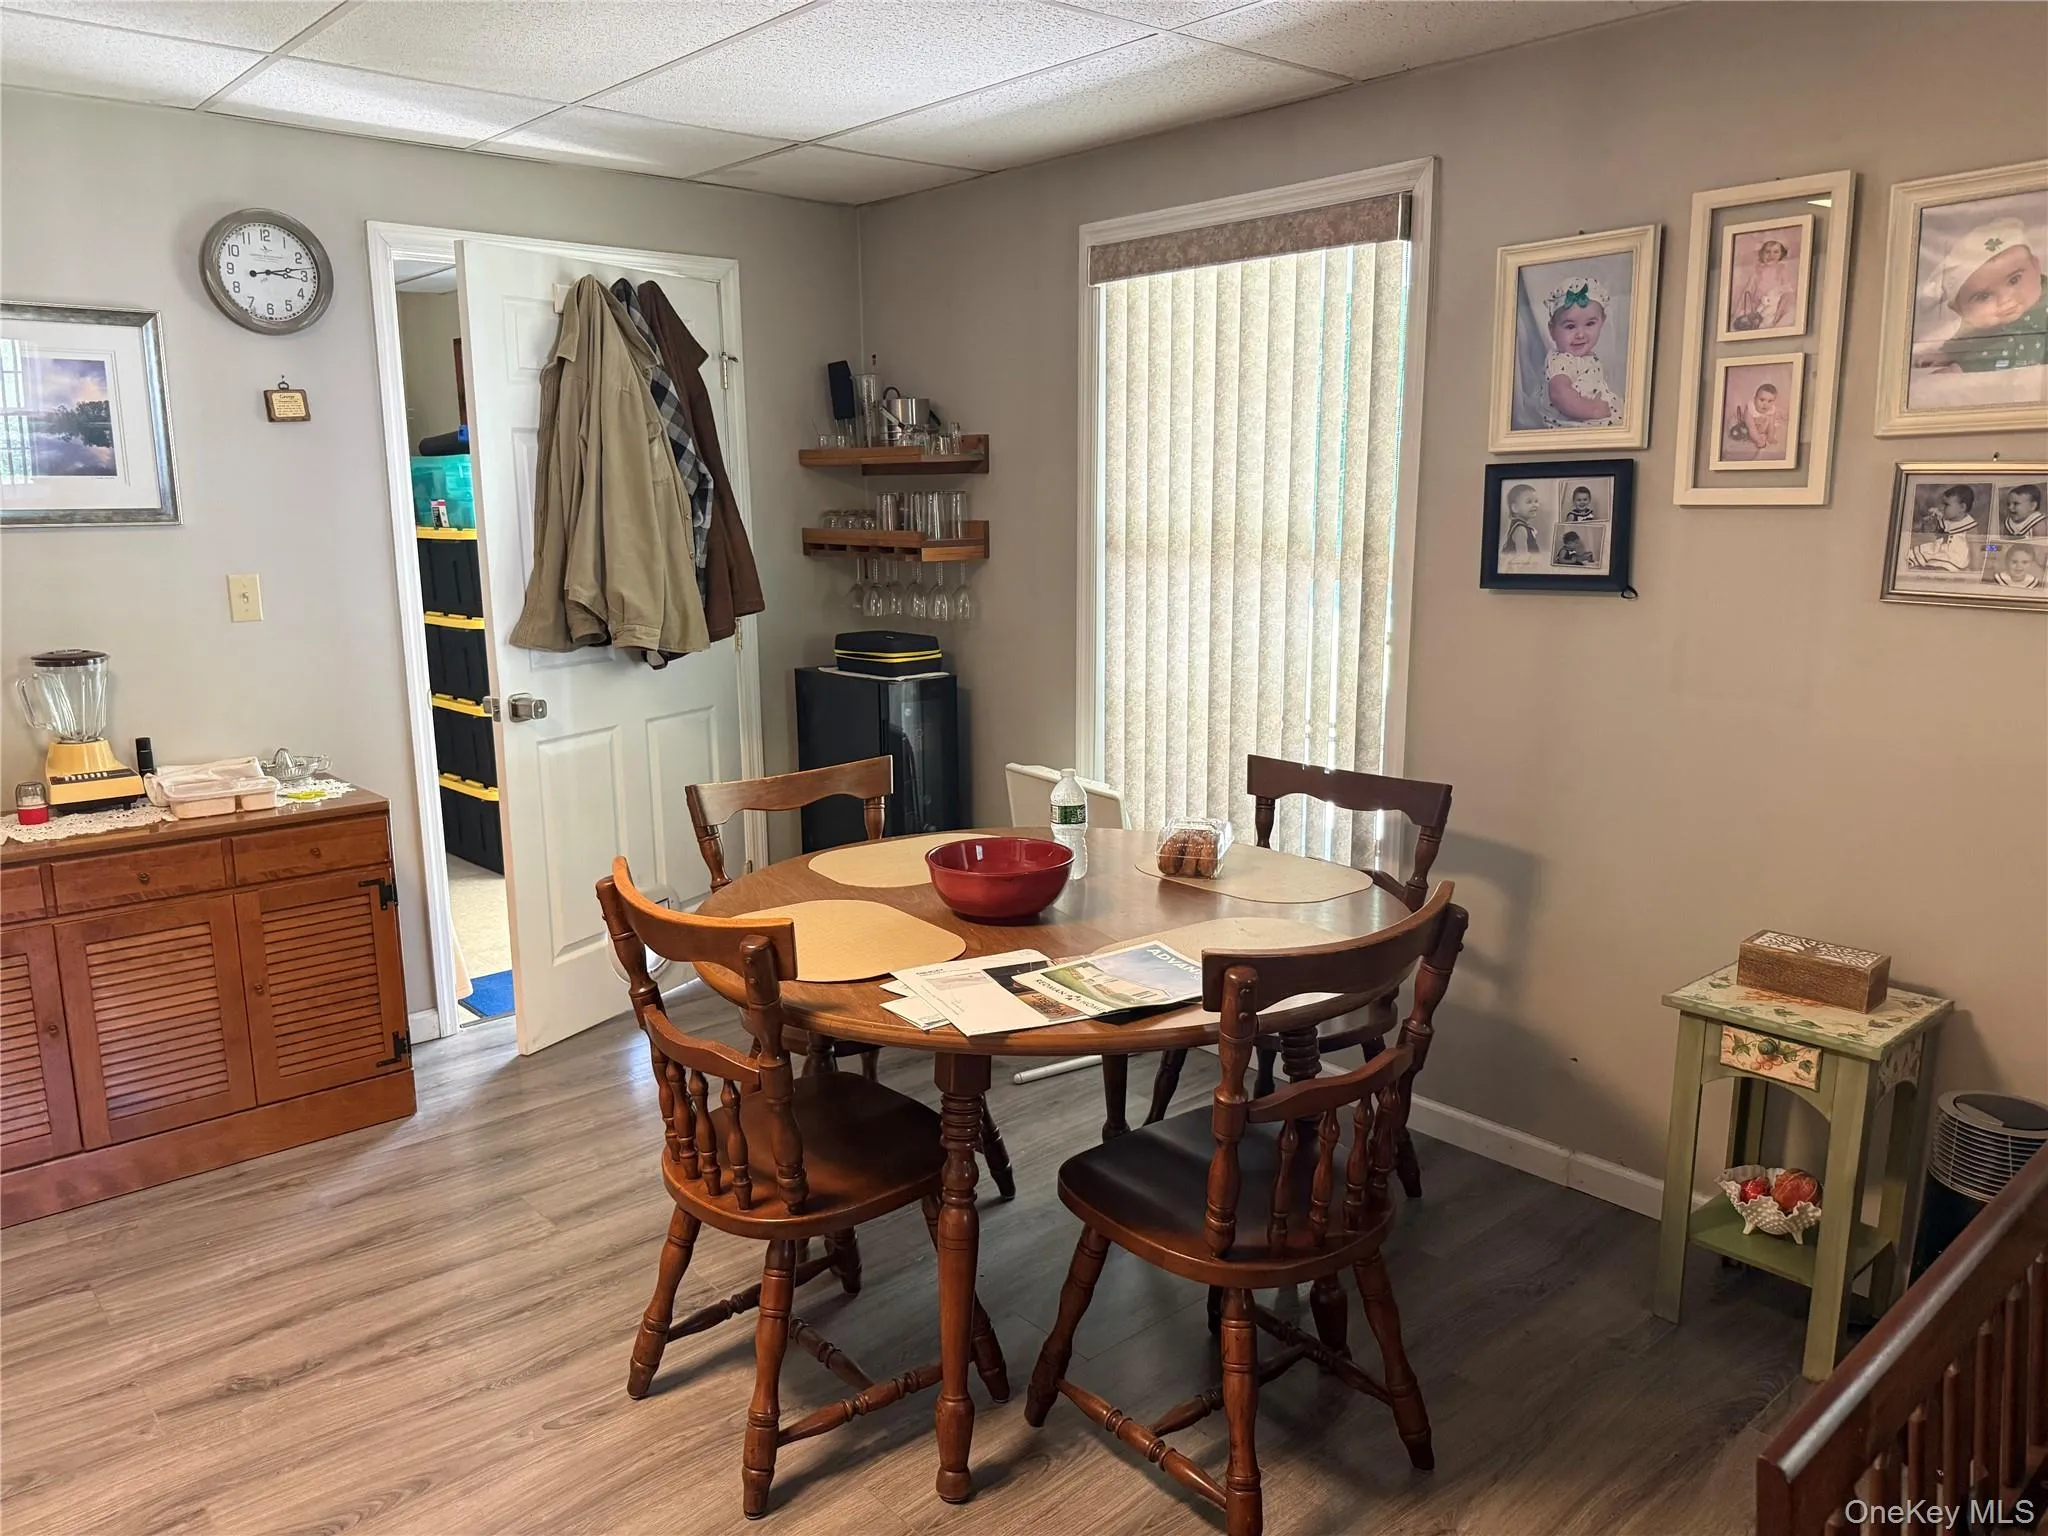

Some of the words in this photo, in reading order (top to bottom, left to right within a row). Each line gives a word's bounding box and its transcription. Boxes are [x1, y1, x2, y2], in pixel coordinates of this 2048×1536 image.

[241, 231, 251, 245] 11
[259, 228, 271, 242] 12
[227, 243, 240, 257] 10
[294, 251, 303, 265] 2
[226, 262, 235, 275] 9
[300, 270, 309, 283] 3
[232, 280, 241, 294] 8
[296, 287, 305, 300] 4
[247, 295, 255, 309] 7
[266, 302, 275, 316] 6
[284, 299, 293, 312] 5
